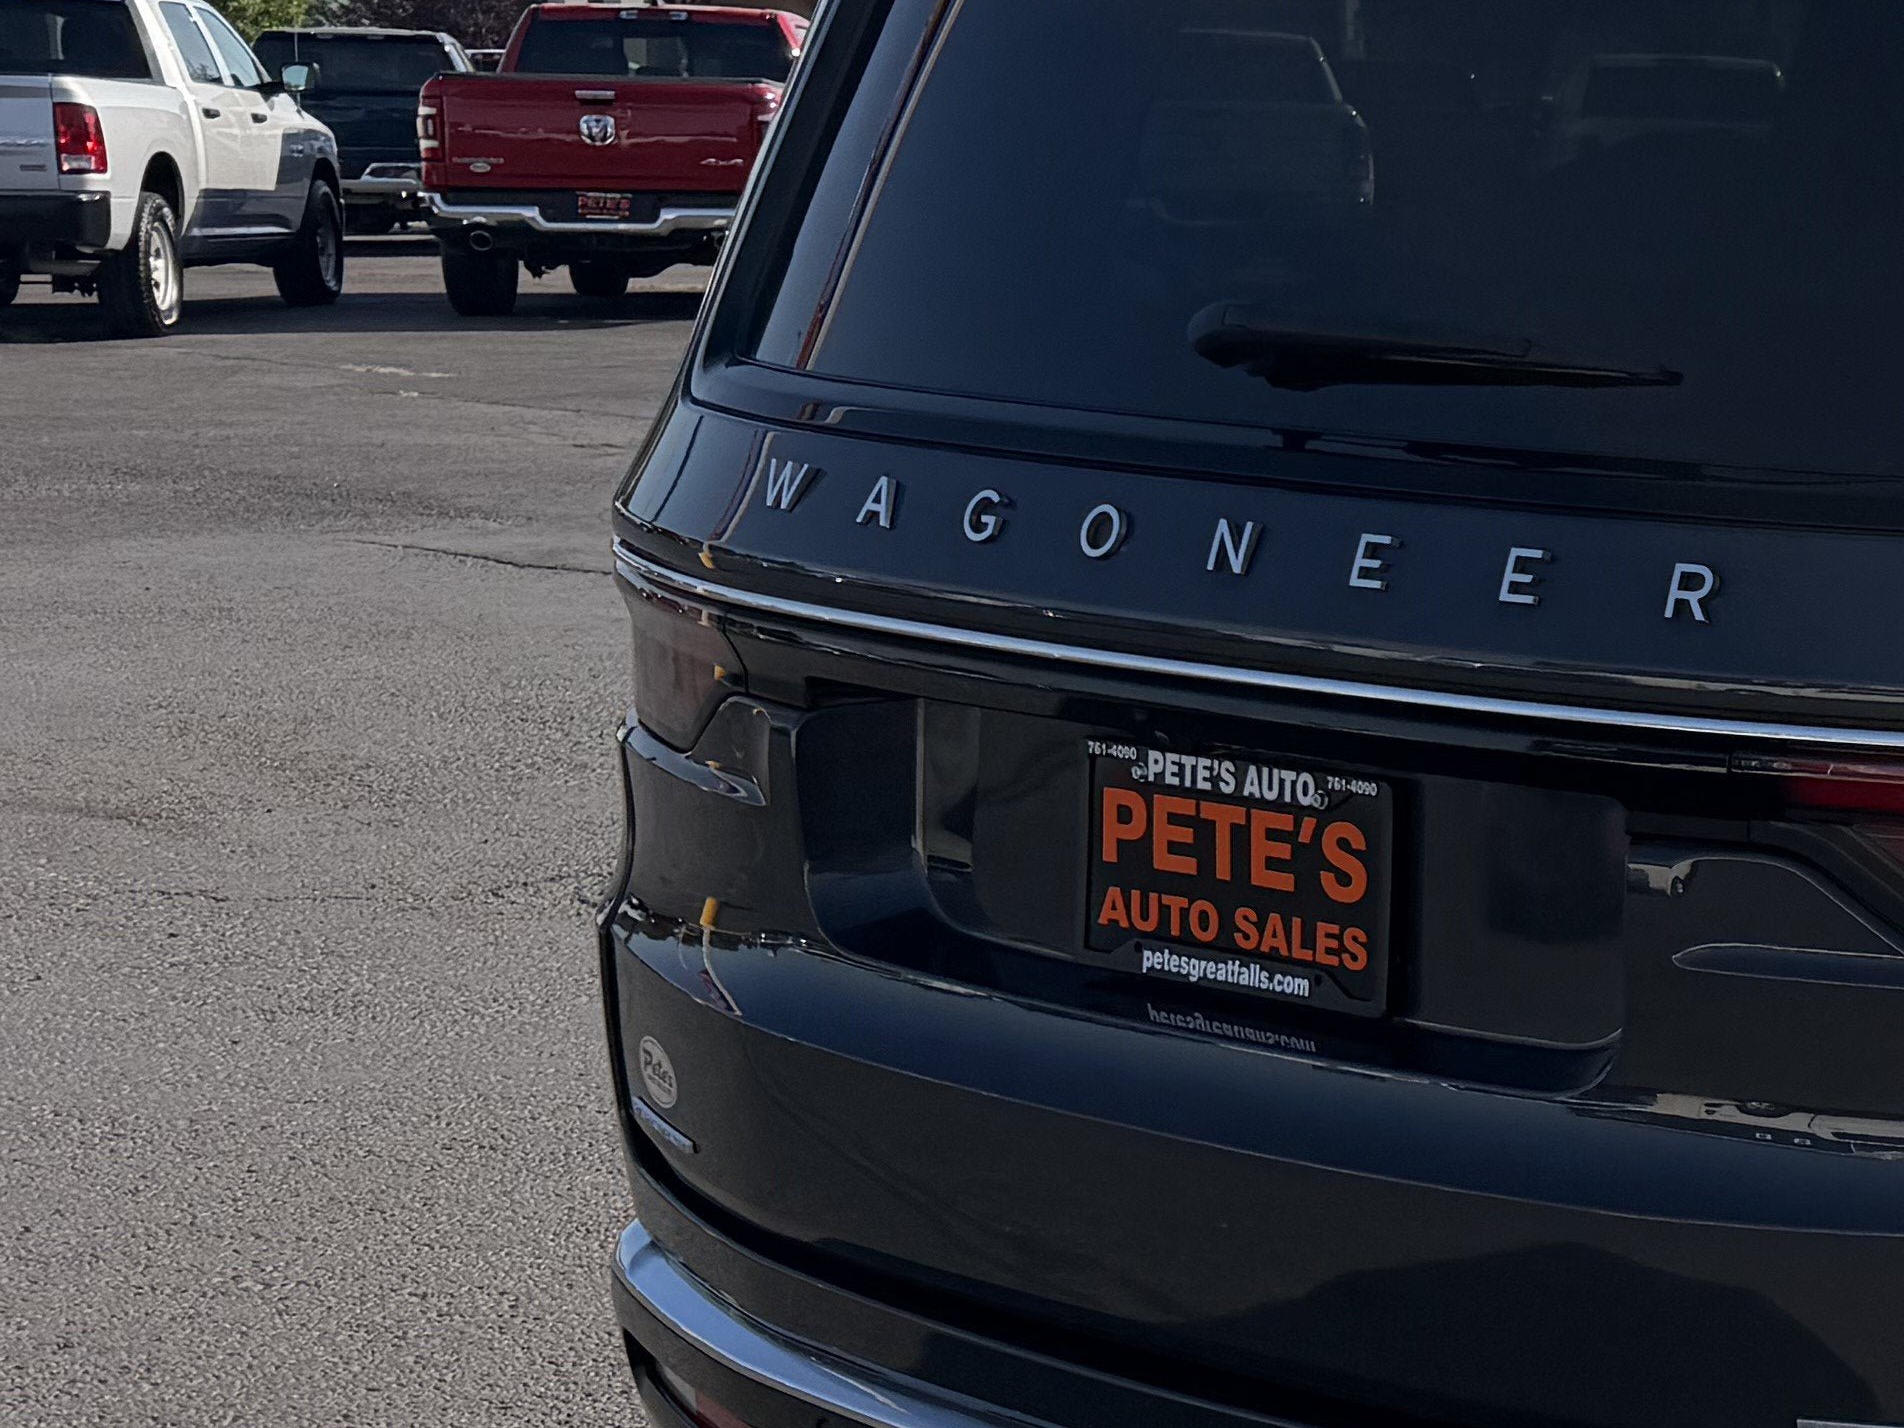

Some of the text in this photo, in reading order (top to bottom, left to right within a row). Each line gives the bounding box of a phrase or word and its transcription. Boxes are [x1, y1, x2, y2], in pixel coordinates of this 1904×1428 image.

[765, 457, 1718, 623] WAGONEER
[1087, 741, 1137, 760] 761-4090
[1147, 749, 1315, 807] PETE'S AUTO
[1326, 776, 1378, 797] 761-4090
[1102, 787, 1368, 904] PETE'S
[1098, 886, 1369, 971] AUTO SALES
[1142, 948, 1310, 997] petesgreatfalls.com
